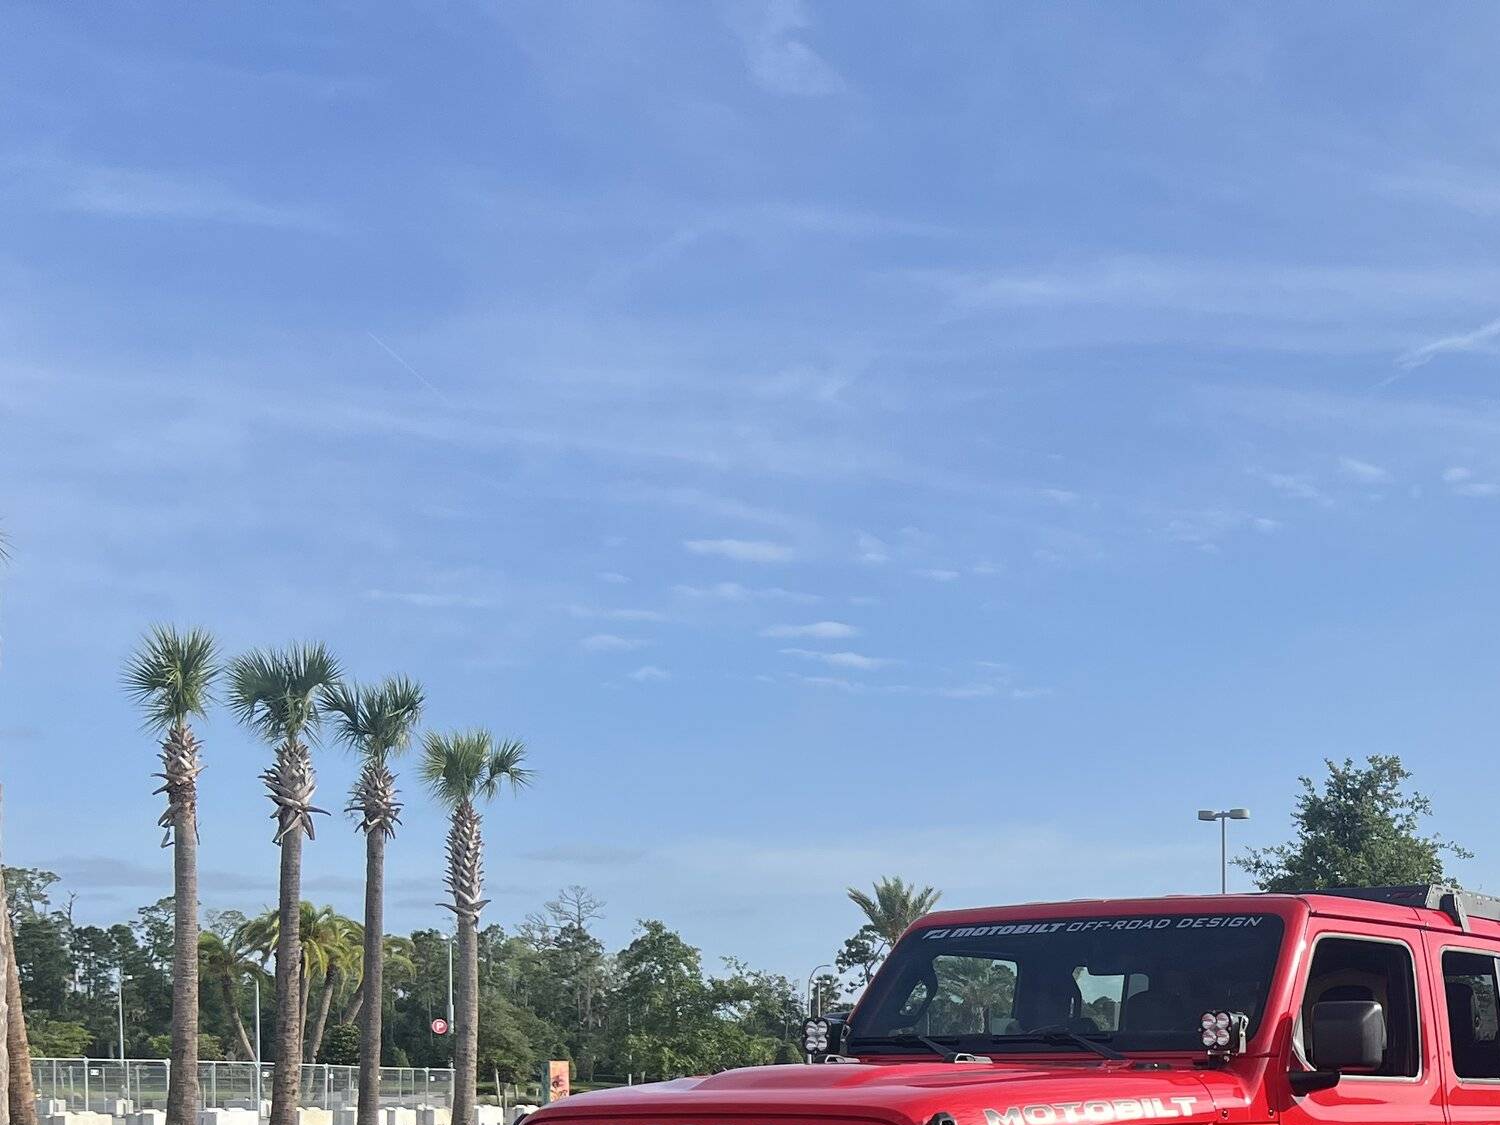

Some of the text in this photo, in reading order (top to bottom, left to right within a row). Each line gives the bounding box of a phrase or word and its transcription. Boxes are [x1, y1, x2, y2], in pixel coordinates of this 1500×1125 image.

[950, 916, 1263, 938] MOTOBILT OFF-ROAD DESIGN
